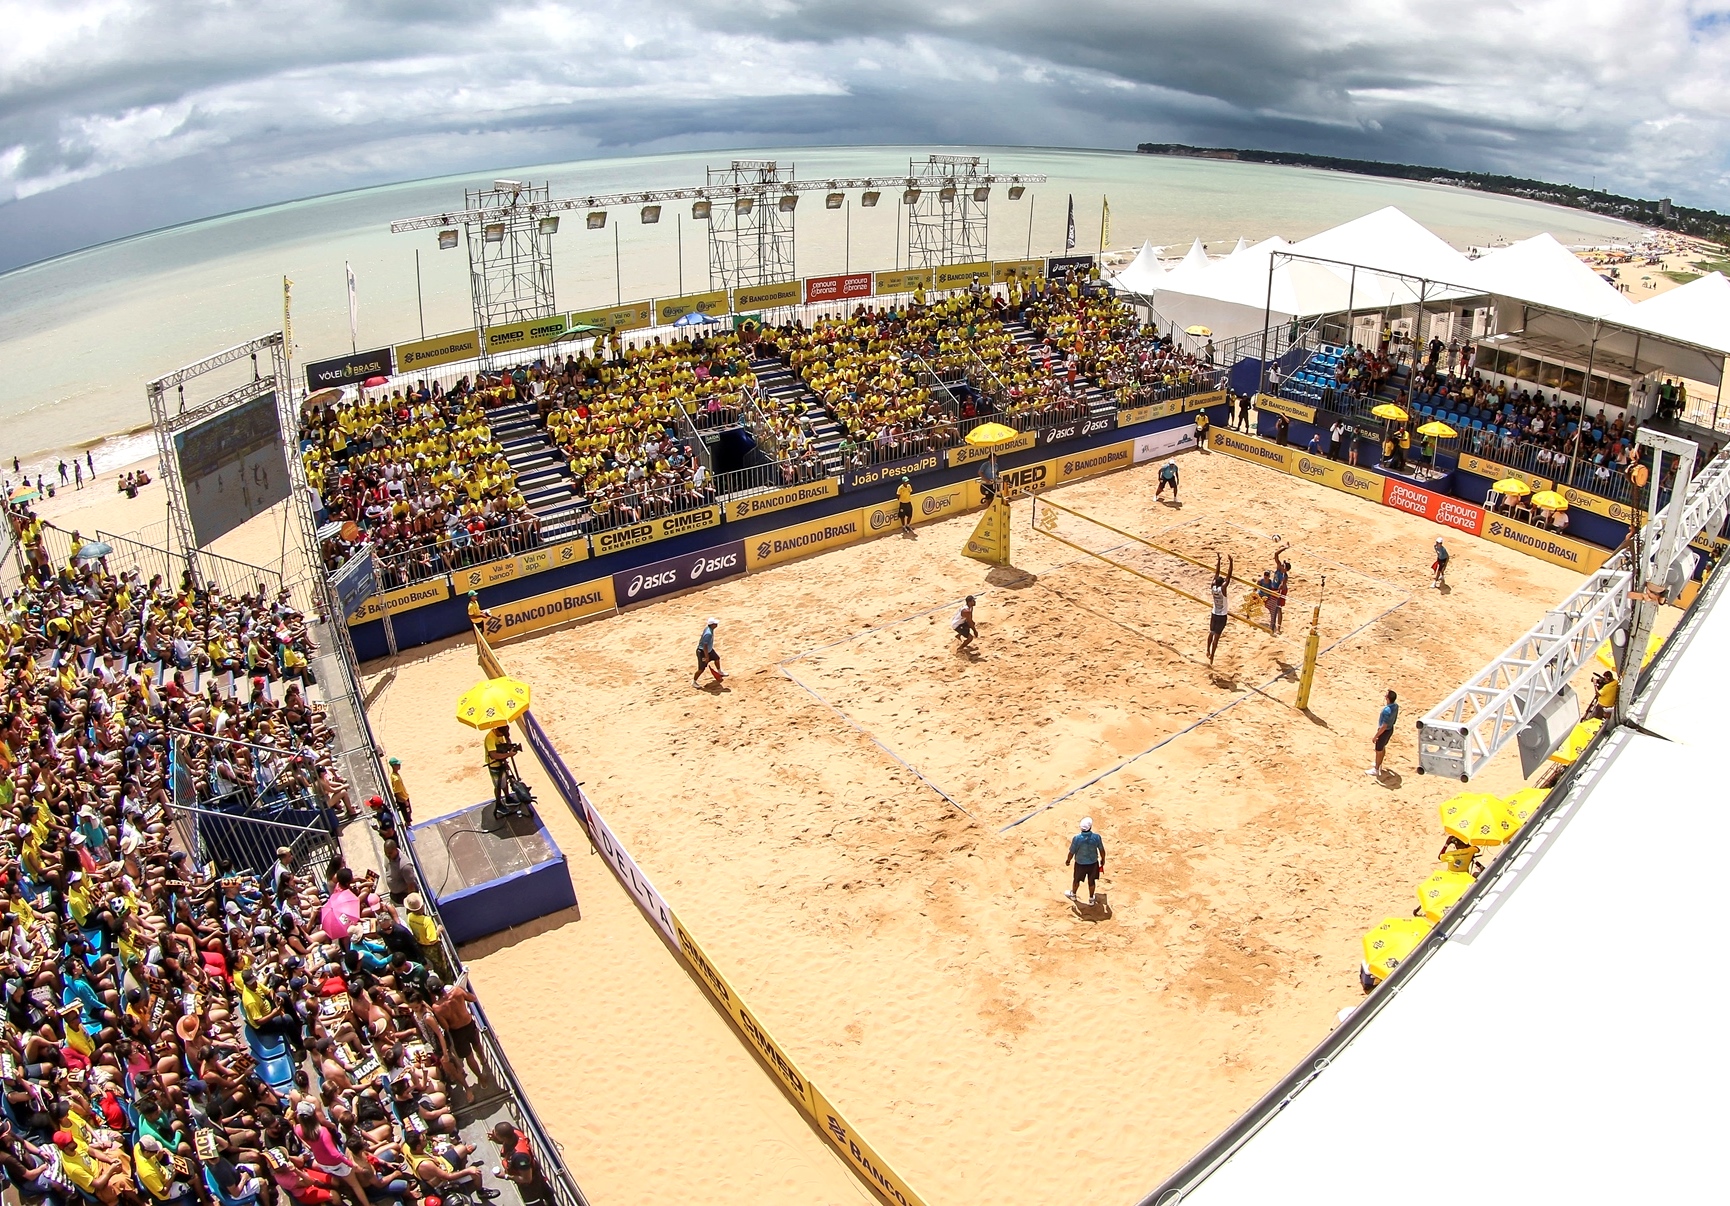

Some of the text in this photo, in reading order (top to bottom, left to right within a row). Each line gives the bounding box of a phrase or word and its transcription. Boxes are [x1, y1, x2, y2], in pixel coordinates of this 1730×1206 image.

[812, 280, 837, 289] cenoura
[844, 278, 867, 287] cenoura
[947, 273, 964, 281] BANCO
[749, 294, 769, 303] BANCO
[778, 290, 796, 299] BRASIL
[490, 330, 524, 342] CIMED
[530, 324, 563, 336] CIMED
[415, 349, 439, 360] BANCO
[450, 342, 473, 354] BRASIL
[318, 362, 381, 381] VÔLEI BRASIL
[1269, 401, 1285, 411] BANCO
[1292, 408, 1308, 418] BRASIL
[1056, 427, 1074, 439] asics
[1091, 420, 1108, 430] asics
[1075, 450, 1128, 470] BANCO DO BRASIL
[1226, 438, 1284, 464] BANCO DO BRASIL
[852, 456, 937, 486] João Pessoa/PB
[1310, 467, 1325, 476] OPEN
[1354, 480, 1369, 490] OPEN
[752, 486, 829, 511] BANCO DO BRASIL
[1394, 485, 1428, 504] cenoura
[1576, 498, 1591, 507] OPEN
[936, 499, 951, 509] OPEN
[1440, 501, 1477, 519] cenoura
[662, 510, 713, 530] CIMED
[664, 520, 713, 536] GENÉRICOS
[600, 525, 652, 546] CIMED
[602, 535, 653, 552] GENÉRICOS
[774, 522, 857, 553] BANCO DO BRASIL
[1504, 527, 1578, 563] BANCO DO BRASIL
[524, 555, 535, 564] Vai
[526, 561, 541, 571] app.
[706, 552, 737, 572] asics
[489, 570, 514, 582] banco?
[492, 565, 503, 573] Vai
[644, 569, 676, 590] asics
[398, 597, 410, 605] DO
[410, 588, 439, 602] BRASIL
[504, 591, 603, 627] BANCO DO BRASIL
[601, 828, 674, 935] DELTA
[678, 928, 729, 1001] CIMED
[740, 1008, 804, 1093] CIMED
[354, 1057, 380, 1079] BLOCK
[198, 1128, 212, 1156] ACE
[850, 1139, 907, 1206] BANCO
